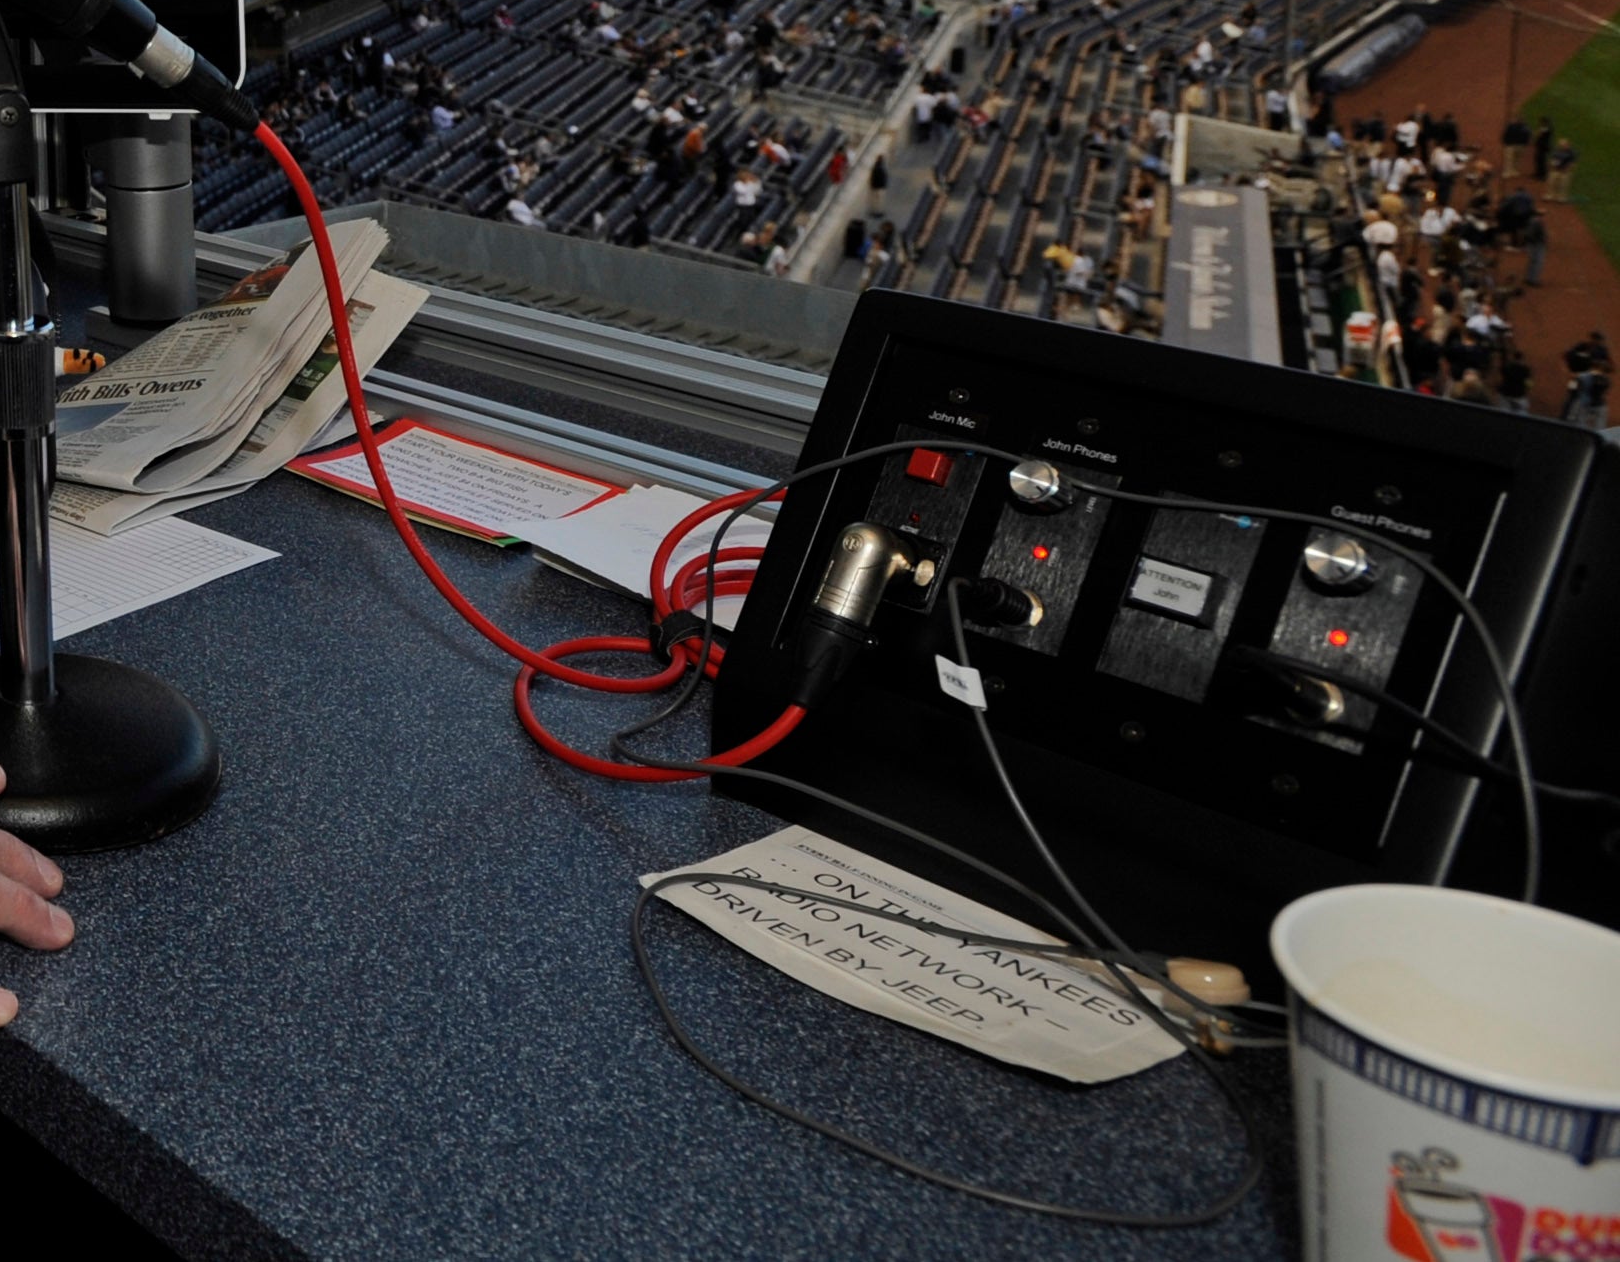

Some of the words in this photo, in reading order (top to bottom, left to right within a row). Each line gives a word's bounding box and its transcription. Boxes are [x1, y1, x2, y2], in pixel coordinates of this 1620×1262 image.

[198, 306, 257, 321] together
[91, 382, 140, 400] Bills'
[139, 378, 206, 395] Owens
[928, 409, 956, 426] John
[956, 415, 977, 430] Mic
[1042, 437, 1071, 454] John
[1072, 443, 1119, 464] Phones
[1330, 504, 1375, 527] Guest
[1375, 515, 1433, 541] Phones
[1152, 588, 1180, 601] John
[693, 880, 825, 949] DRIVEN
[824, 948, 884, 972] BY
[880, 977, 986, 1030] JEEP.
[814, 873, 870, 900] ON
[957, 937, 1141, 1026] YANKEES
[845, 922, 1044, 1018] NETWORK
